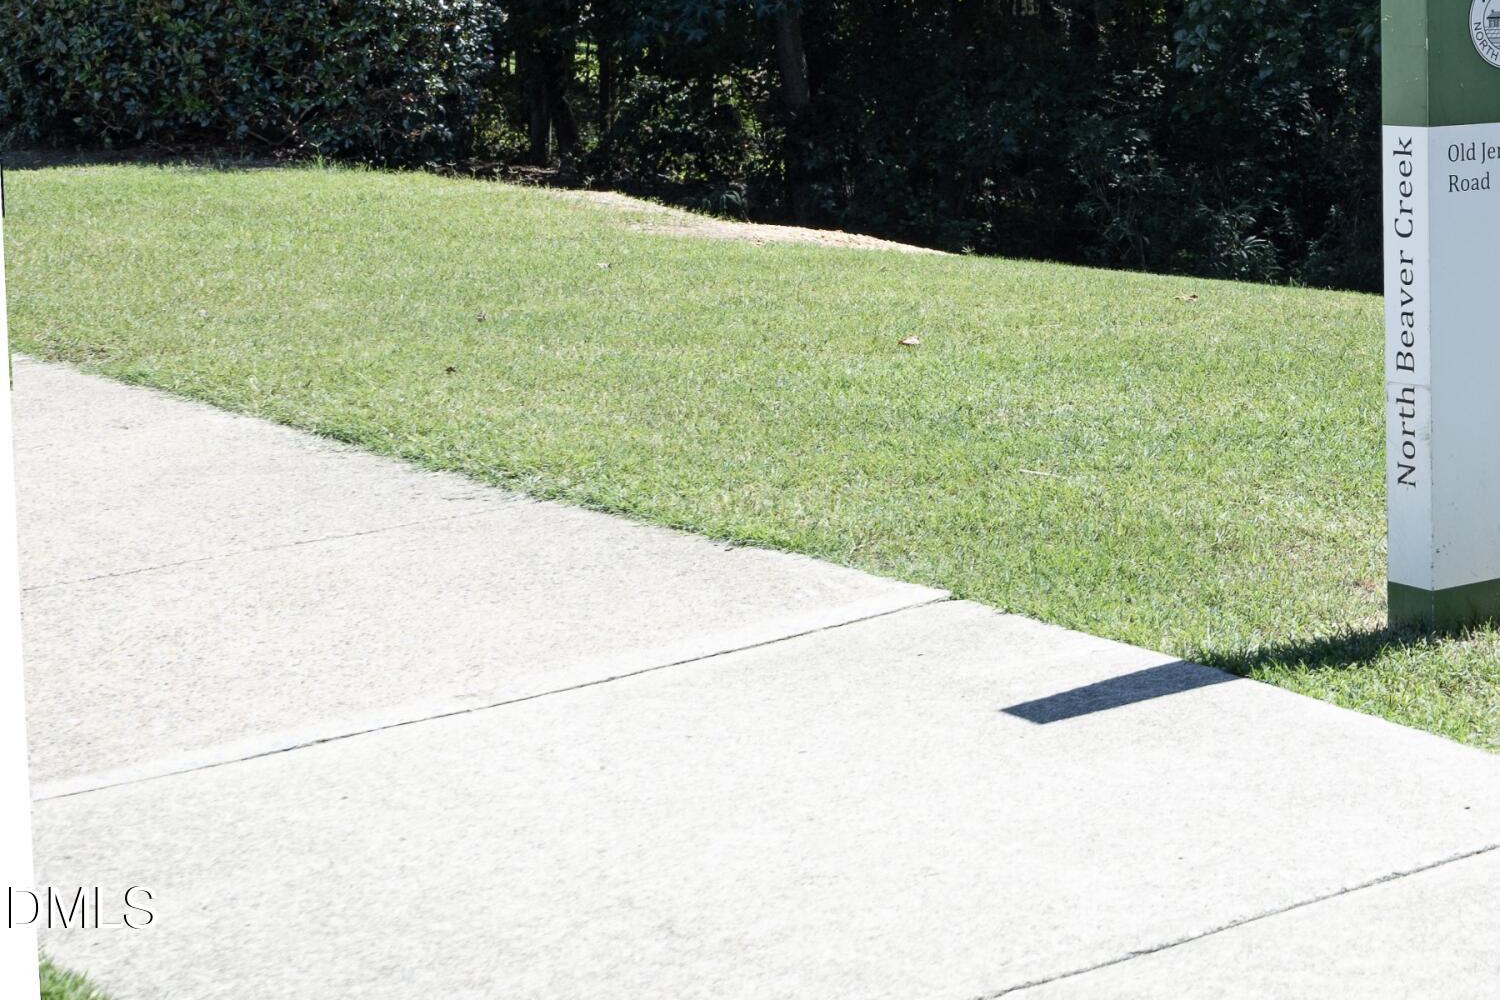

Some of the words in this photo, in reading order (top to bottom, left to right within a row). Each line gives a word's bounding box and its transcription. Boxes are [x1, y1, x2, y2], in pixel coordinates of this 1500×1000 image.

[1473, 21, 1499, 61] NORTH
[1392, 136, 1414, 238] Creek
[1448, 142, 1476, 162] Old
[1448, 171, 1491, 193] Road
[1395, 249, 1415, 373] Beaver
[1395, 385, 1416, 488] North
